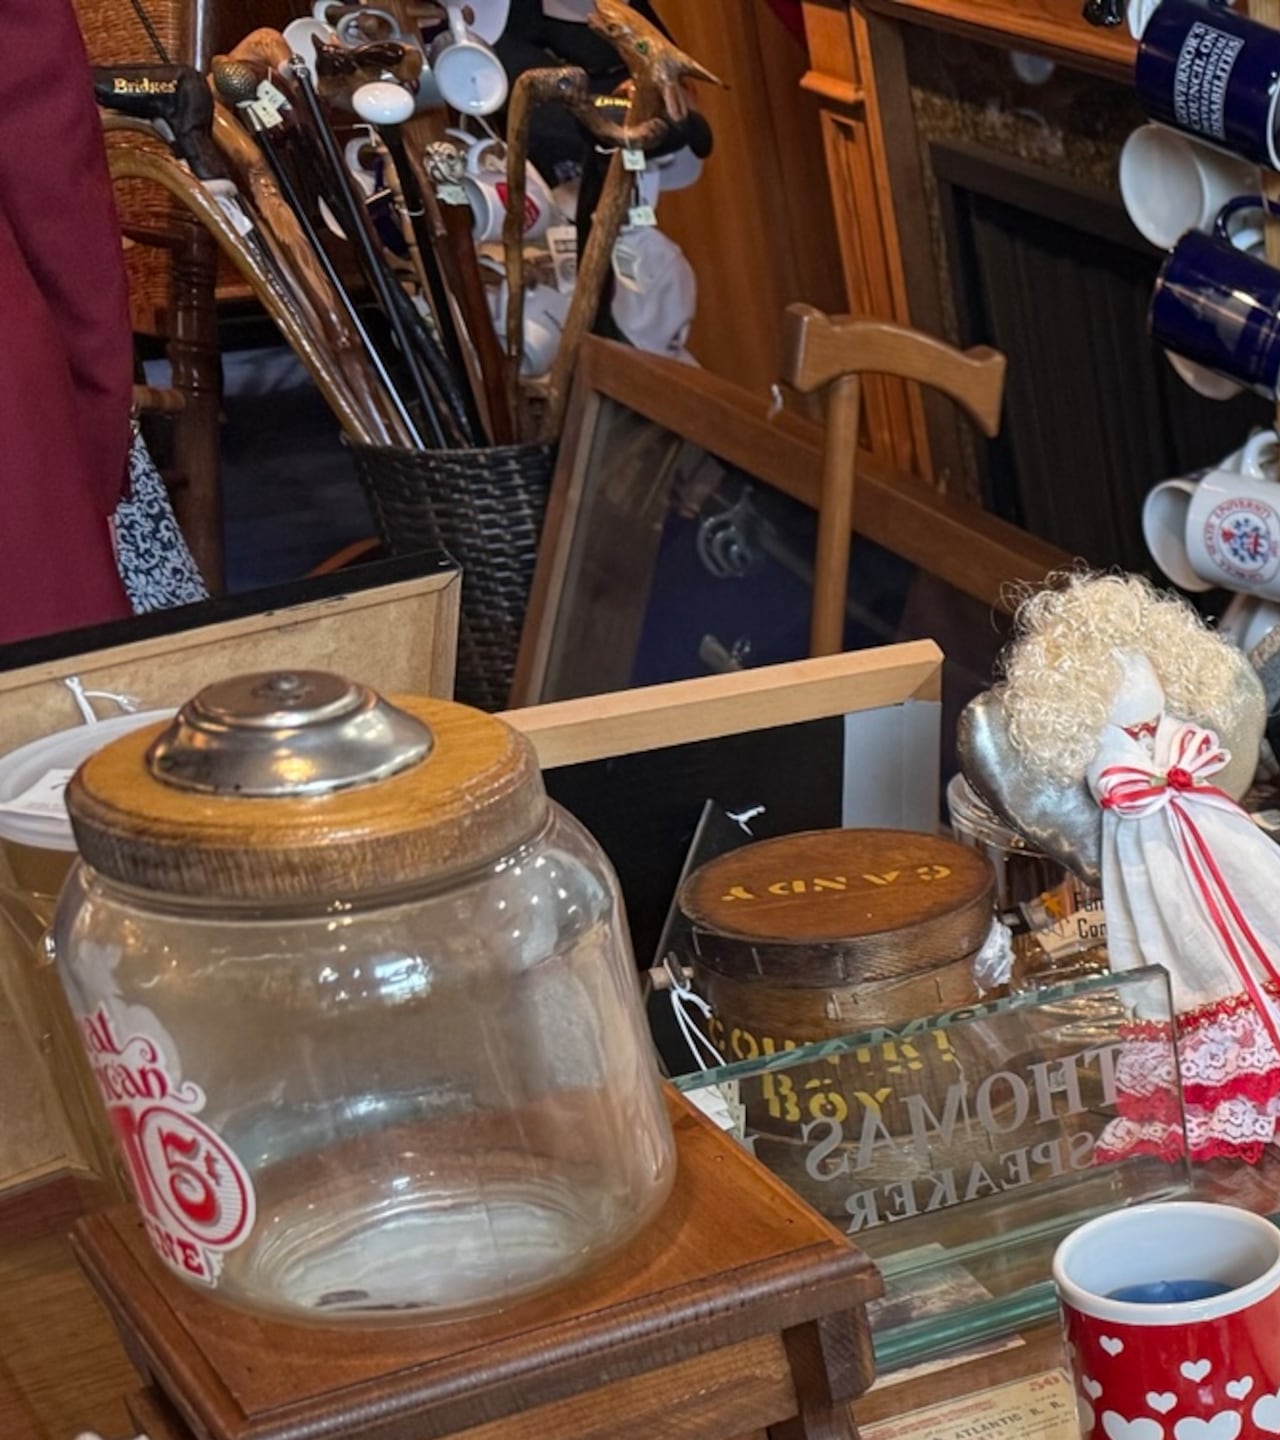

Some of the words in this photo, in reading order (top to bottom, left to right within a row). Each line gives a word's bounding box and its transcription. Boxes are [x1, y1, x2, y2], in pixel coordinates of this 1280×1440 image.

[1187, 55, 1207, 130] COUNCIL
[1200, 32, 1218, 54] ON
[721, 865, 953, 902] CANDY
[954, 1412, 1023, 1440] ATLANTIC
[1029, 1407, 1046, 1417] R.
[1049, 1400, 1066, 1410] R.
